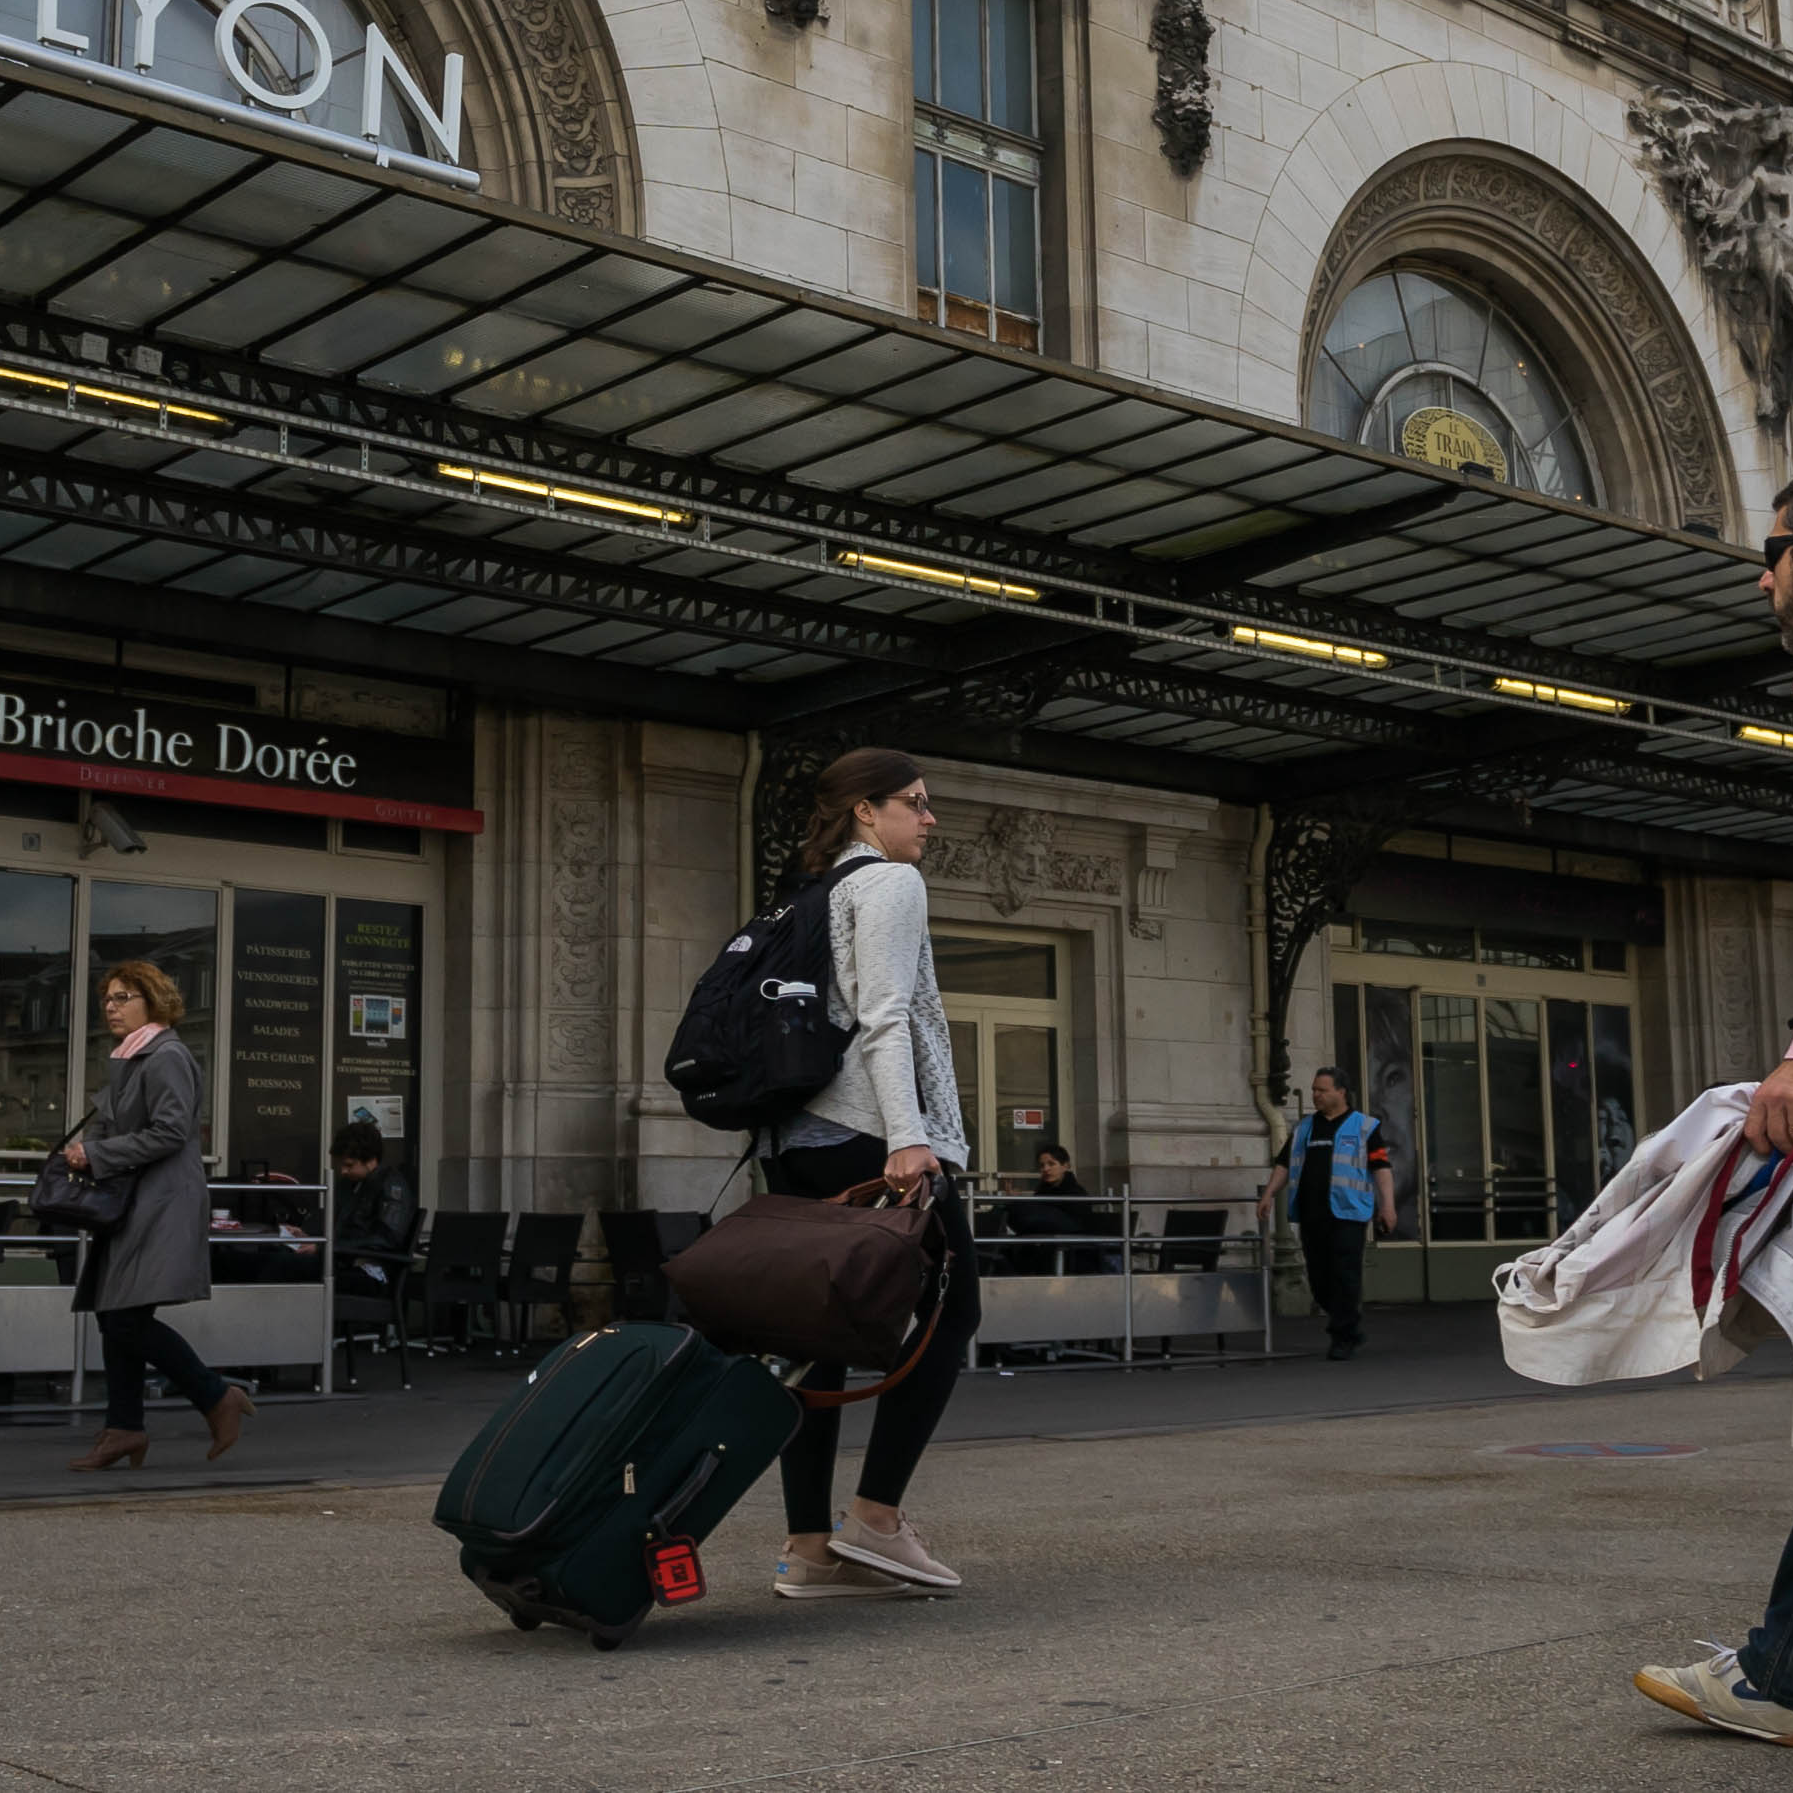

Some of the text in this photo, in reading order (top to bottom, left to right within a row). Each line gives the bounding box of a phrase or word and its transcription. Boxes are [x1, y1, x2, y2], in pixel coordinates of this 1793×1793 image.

[1449, 421, 1461, 436] LE
[1434, 431, 1476, 461] TRAIN
[215, 724, 358, 789] Dorée
[237, 970, 319, 987] VIENNOISERIES
[245, 997, 310, 1013] SANDWICHS
[253, 1023, 302, 1038] SALADES
[236, 1050, 315, 1065] PLATS CHAUDS
[247, 1077, 303, 1092] BOISSONS
